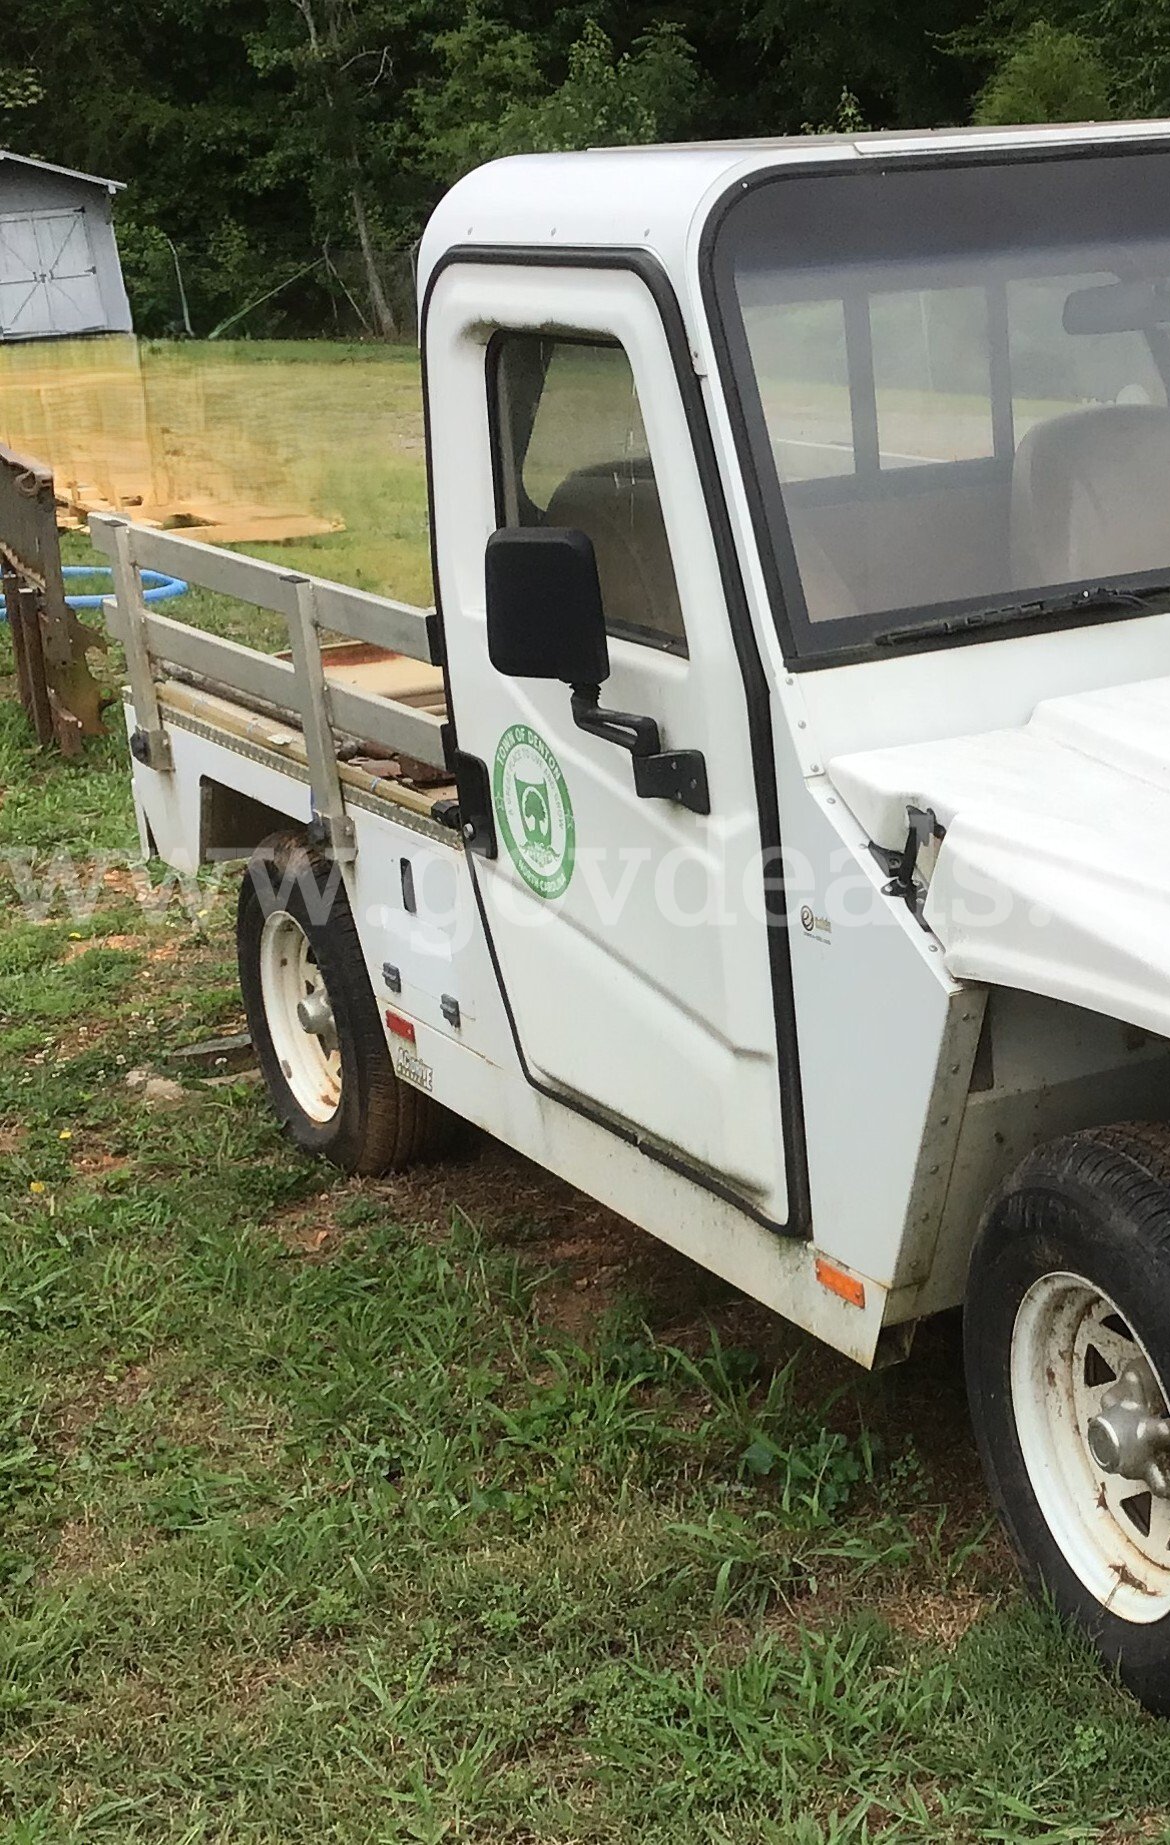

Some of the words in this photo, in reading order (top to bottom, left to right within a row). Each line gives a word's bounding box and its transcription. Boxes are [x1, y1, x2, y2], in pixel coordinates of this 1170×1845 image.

[496, 730, 516, 767] TOWN
[514, 727, 526, 742] OF
[527, 730, 561, 781] DENTON
